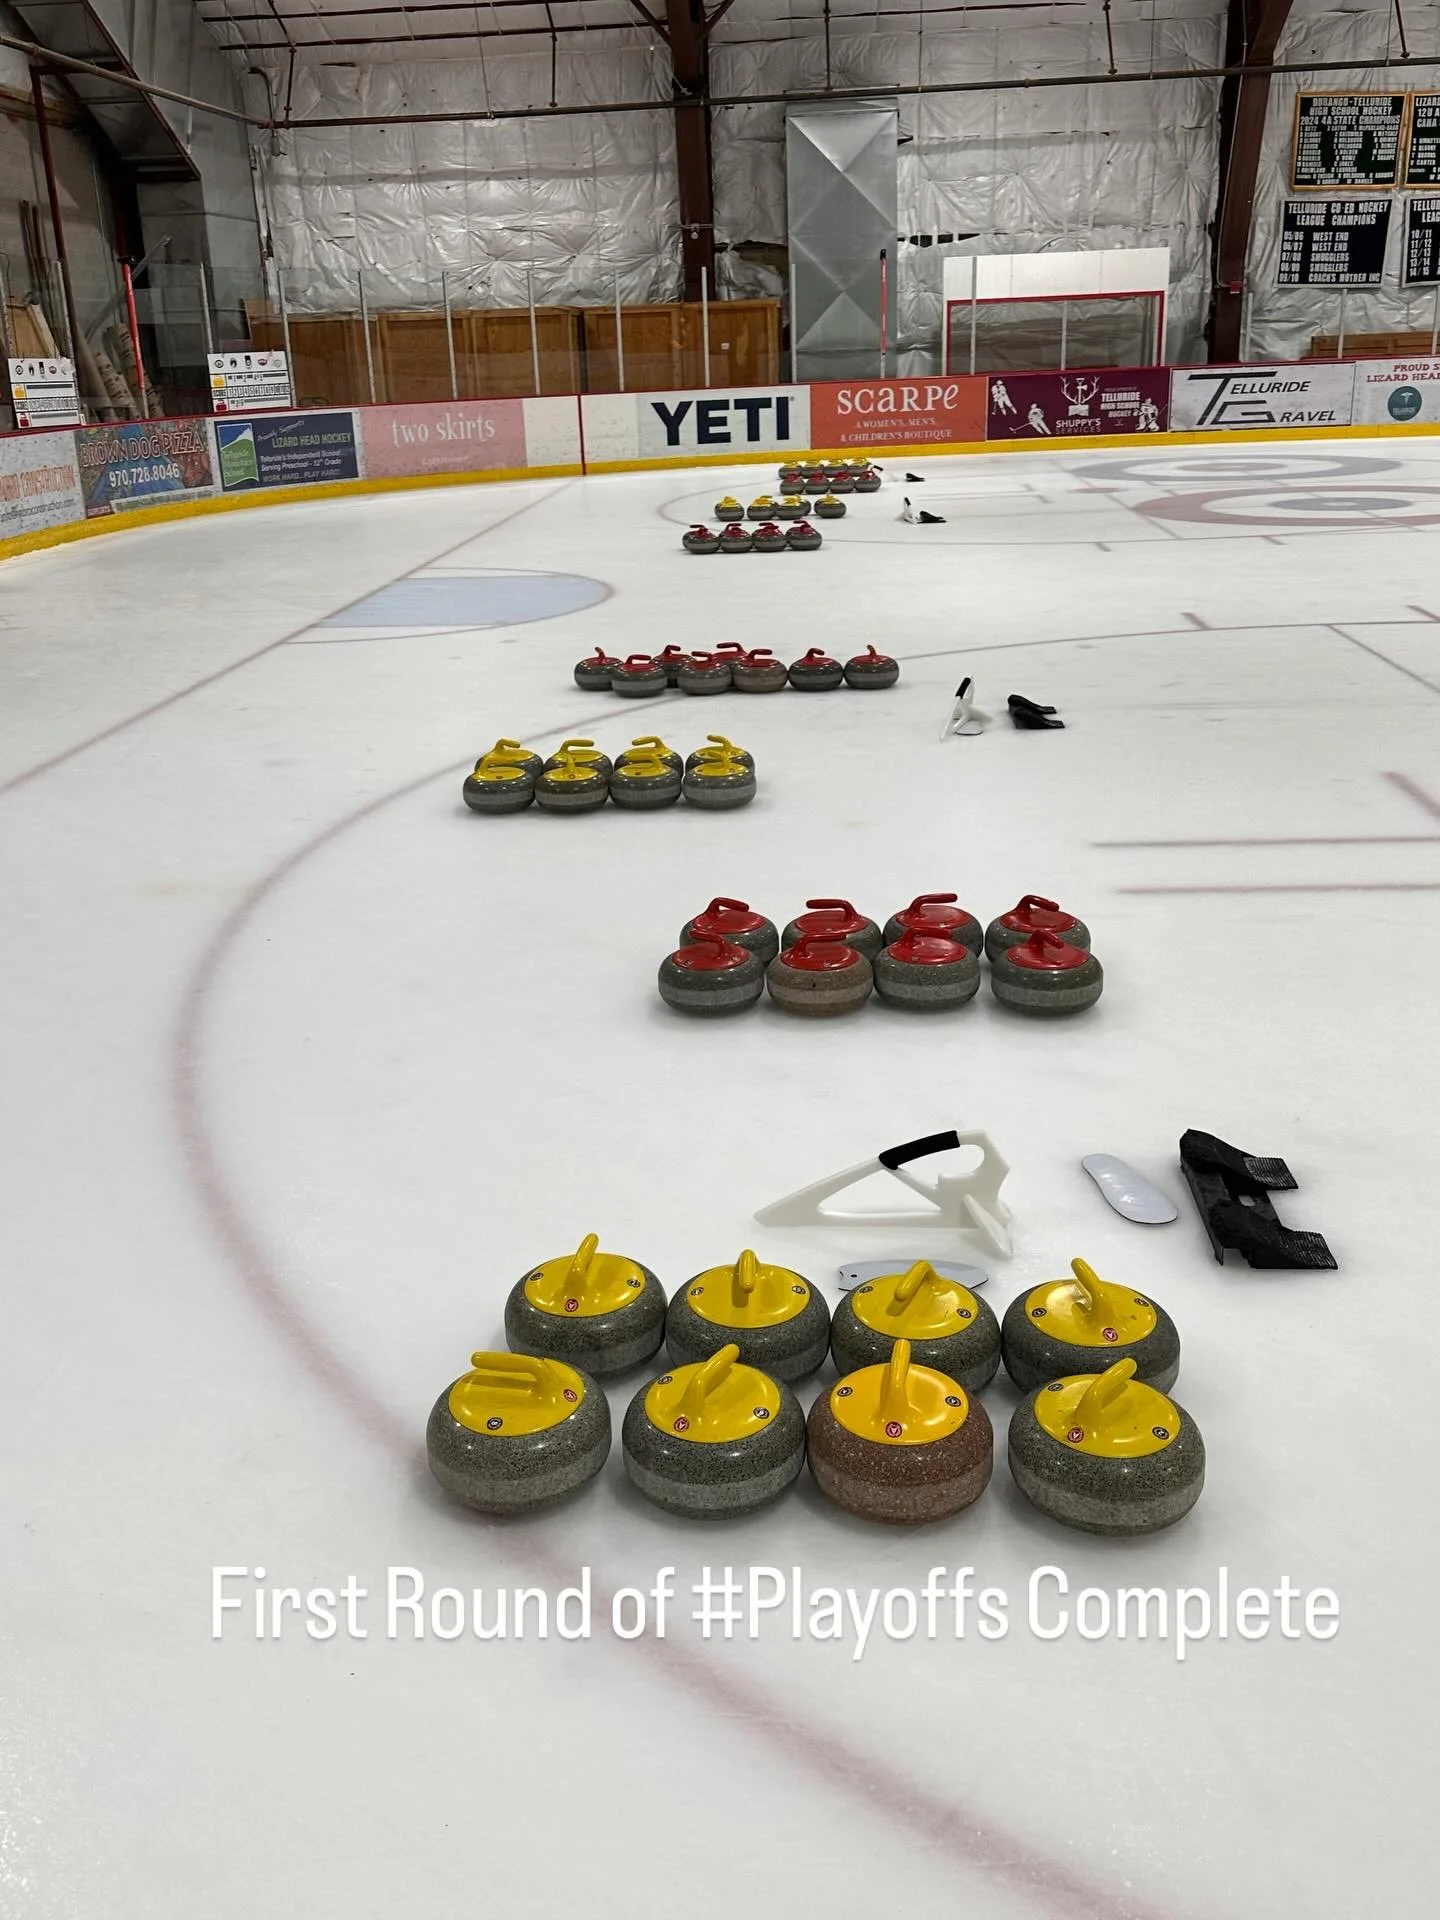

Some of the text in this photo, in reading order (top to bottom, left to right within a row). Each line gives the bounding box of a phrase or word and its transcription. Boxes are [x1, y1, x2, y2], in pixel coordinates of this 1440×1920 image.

[1309, 106, 1392, 116] HIGH SCHOOL HOCKEY
[1333, 116, 1356, 125] STATE
[1359, 115, 1400, 125] CHAMPIONS
[1288, 203, 1327, 214] TELLURIDE
[1358, 201, 1389, 213] HOCKEY
[1296, 214, 1377, 226] LEAGUE CHAMPIONS
[1312, 232, 1333, 241] WEST
[1335, 232, 1349, 241] END
[1311, 242, 1332, 251] WEST
[1334, 242, 1348, 251] END
[1393, 363, 1430, 372] PROUD
[1366, 373, 1409, 383] LIZARD
[1101, 392, 1141, 402] TELLURIDE
[1187, 371, 1312, 425] TELLURIDE
[1210, 400, 1337, 425] GRAVEL
[651, 396, 790, 446] YETI
[1055, 418, 1102, 428] SHUPPY'S
[392, 412, 496, 448] two skirts
[848, 431, 902, 441] CHILDREN'S
[904, 429, 952, 440] BOUTIQUE
[1055, 426, 1102, 435] SERVICES
[272, 433, 352, 448] LIZARD HEAD HOCKEY
[80, 431, 204, 468] BROWN DOG PIZZA
[109, 463, 180, 487] 970.728.8046
